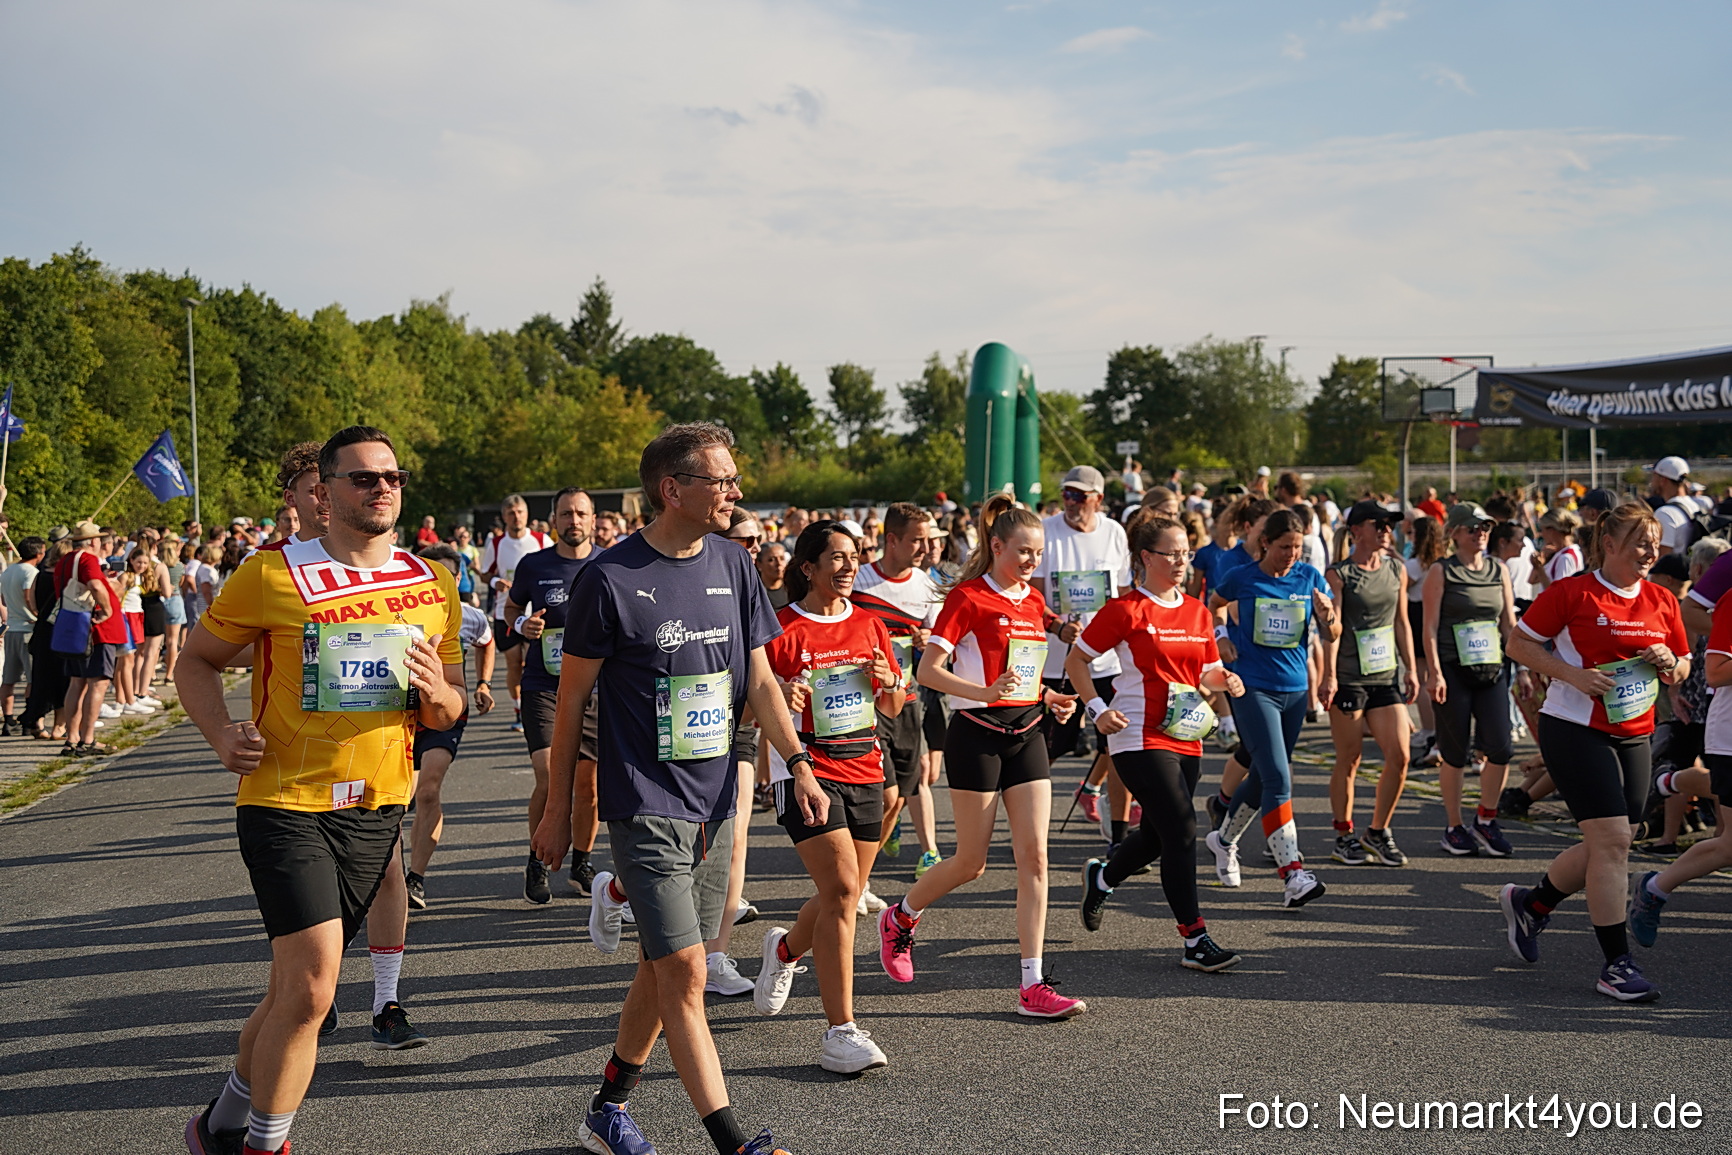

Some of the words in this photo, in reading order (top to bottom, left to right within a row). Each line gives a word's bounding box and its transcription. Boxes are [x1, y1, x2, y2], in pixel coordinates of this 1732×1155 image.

[1547, 386, 1588, 416] Hier
[1586, 382, 1674, 425] gewinnt
[1672, 377, 1717, 412] das
[1068, 587, 1095, 598] 1449
[310, 599, 380, 624] MAX
[384, 588, 446, 613] BÖGL
[1268, 617, 1289, 630] 1511
[1609, 618, 1645, 627] Sparkasse
[684, 625, 730, 643] Firmenlauf
[1468, 638, 1489, 648] 490
[813, 648, 850, 660] Sparkasse
[1371, 645, 1386, 655] 491
[339, 660, 390, 679] 1786
[1014, 664, 1036, 678] 2568
[328, 682, 360, 690] Siemon
[360, 682, 400, 690] Piotrowski
[823, 691, 863, 710] 2553
[1607, 698, 1635, 710] Stephanie
[686, 706, 727, 728] 2034
[828, 711, 849, 719] Marina
[1179, 708, 1206, 723] 2537
[683, 730, 711, 739] Michael
